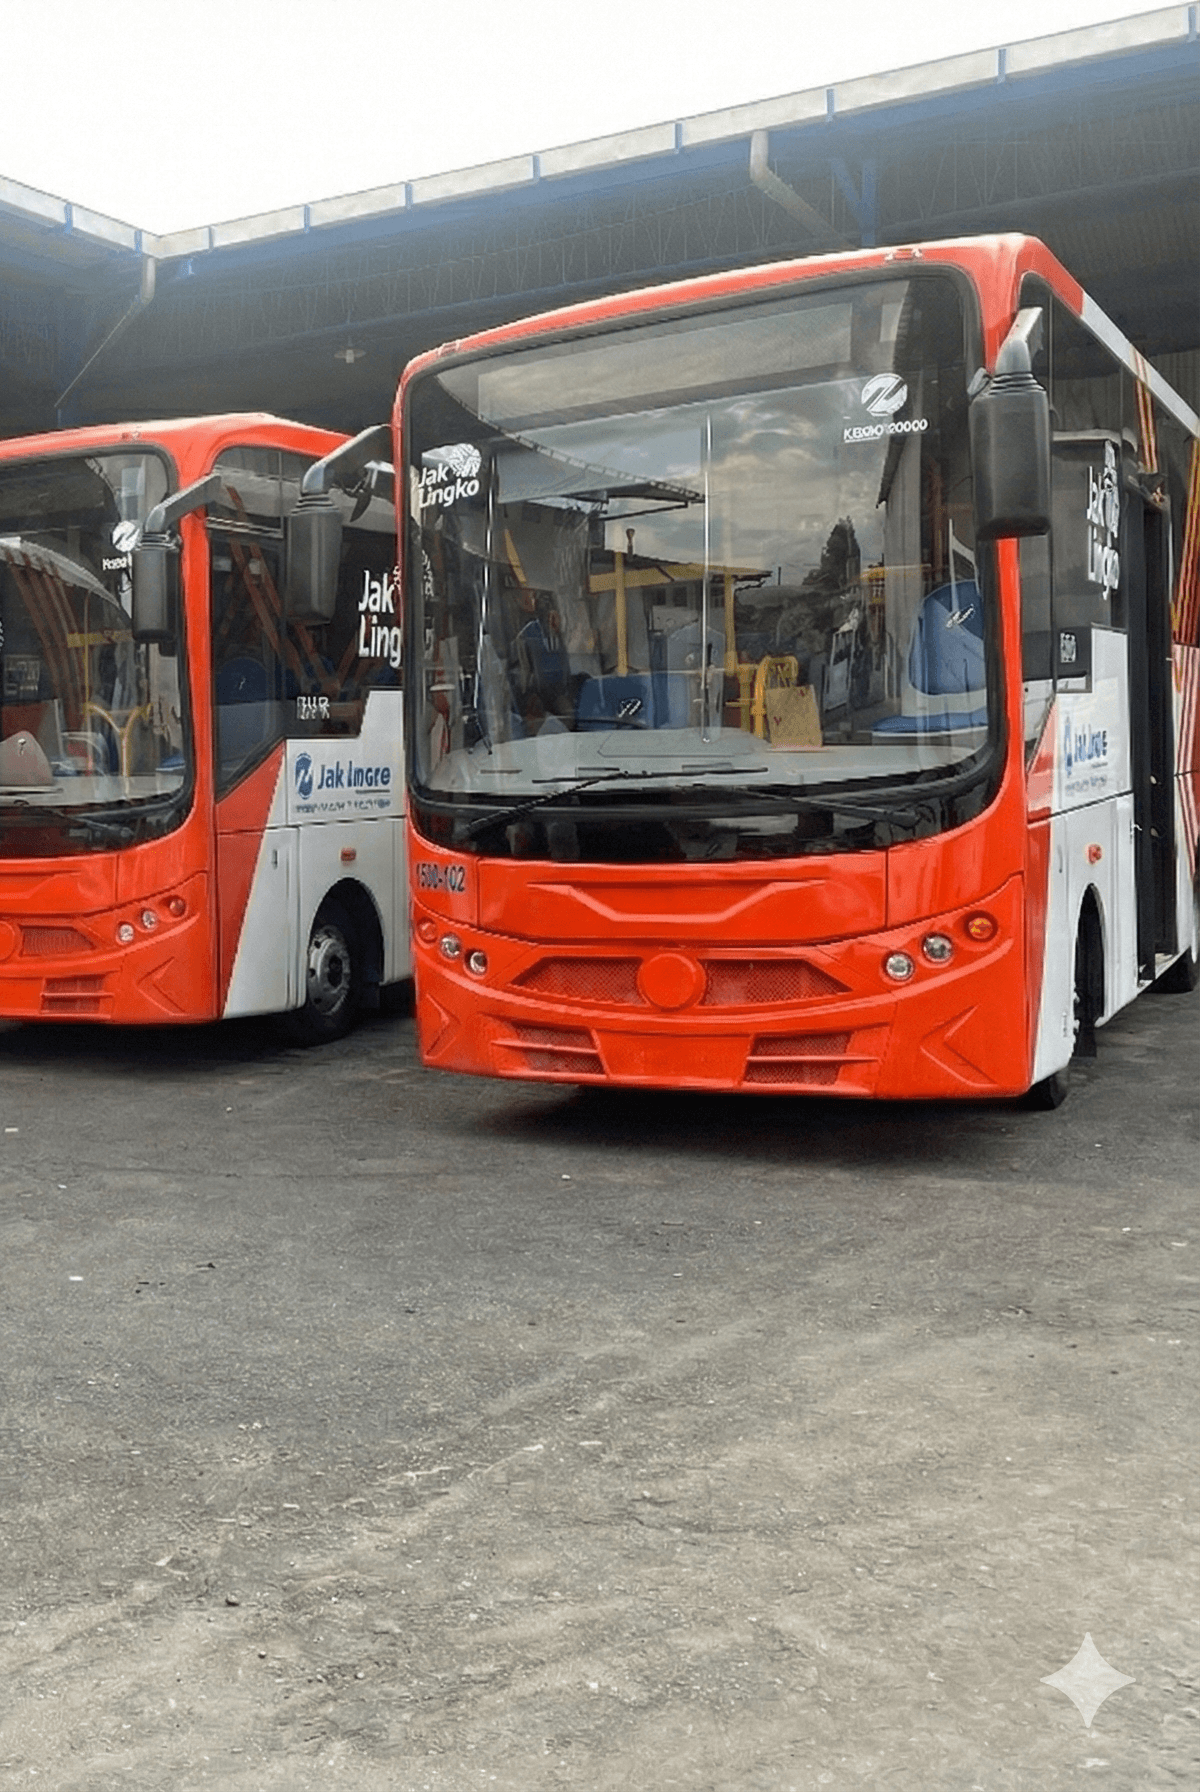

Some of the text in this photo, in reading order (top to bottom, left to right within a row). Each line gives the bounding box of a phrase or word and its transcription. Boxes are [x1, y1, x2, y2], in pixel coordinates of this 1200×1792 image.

[418, 462, 450, 488] Jak
[418, 478, 480, 508] Lingko
[358, 570, 394, 613] Jak
[317, 760, 344, 789] Jak
